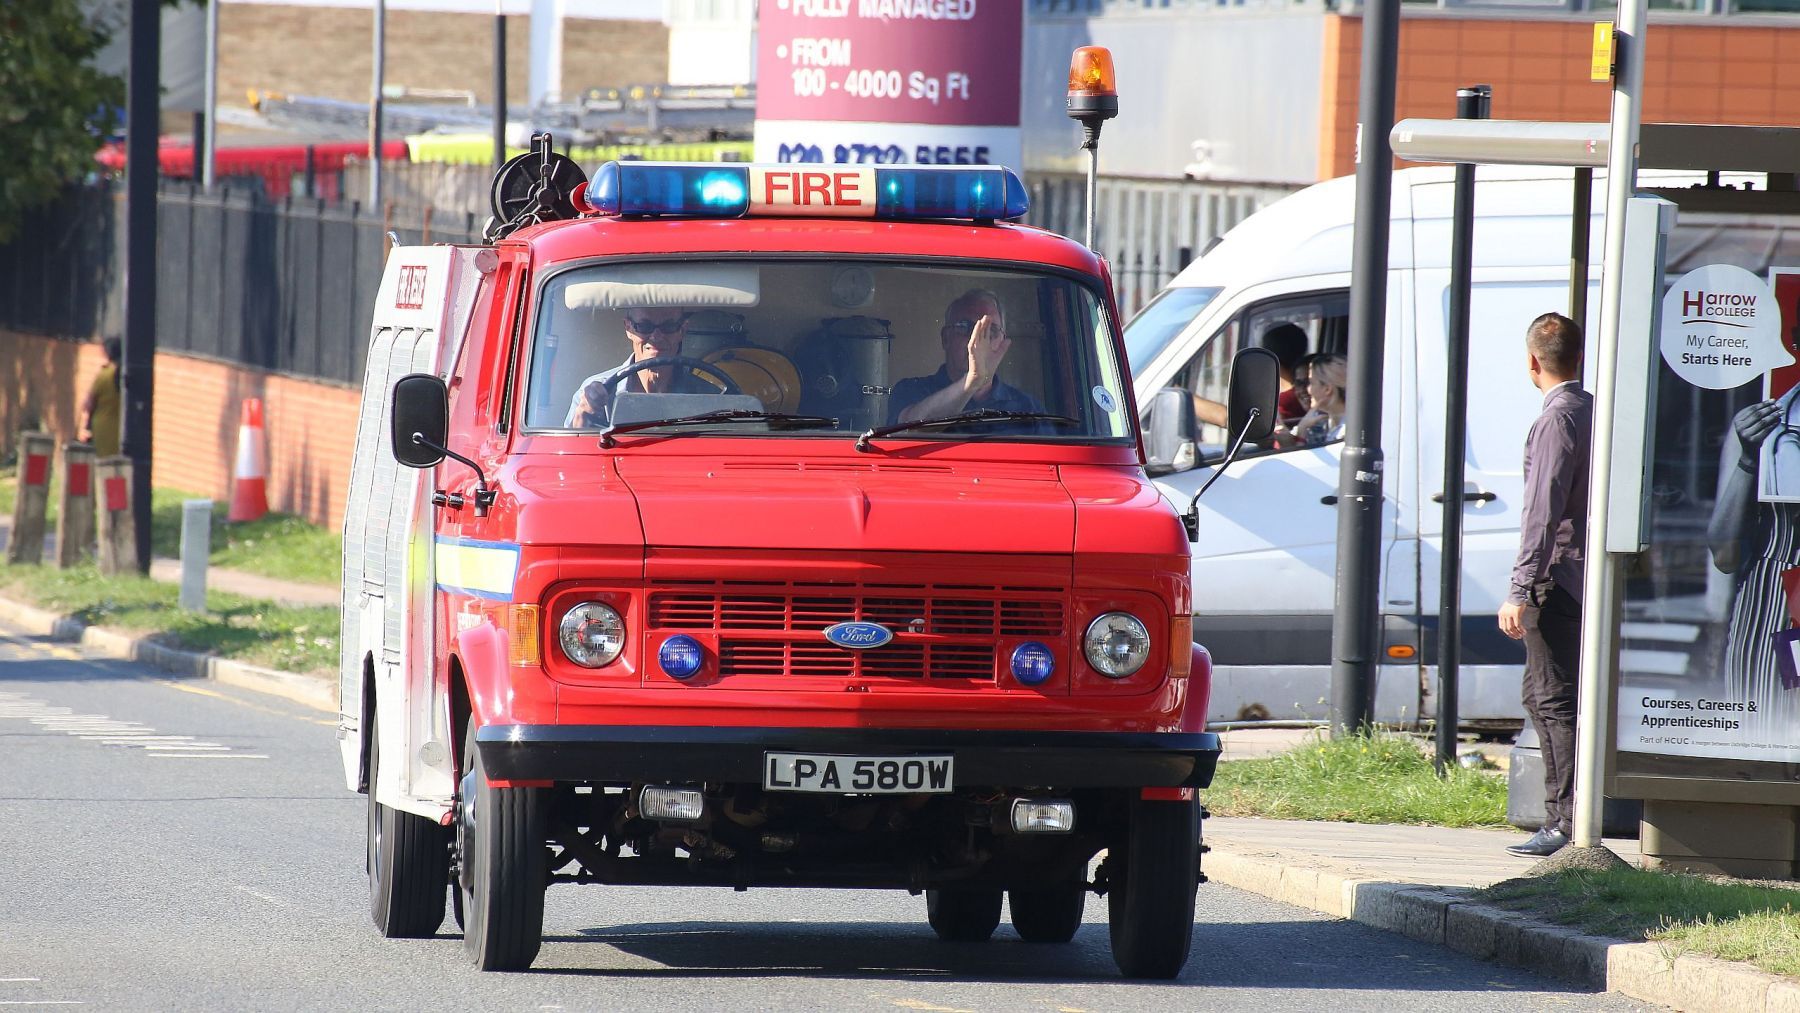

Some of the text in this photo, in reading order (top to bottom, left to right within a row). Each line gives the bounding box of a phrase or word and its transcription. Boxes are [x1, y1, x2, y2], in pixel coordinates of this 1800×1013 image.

[793, 0, 977, 20] FULLY MANAGED
[791, 38, 851, 66] FROM
[791, 69, 826, 97] 100
[844, 70, 902, 98] 4000
[908, 71, 940, 104] Sq
[946, 73, 970, 99] Ft
[765, 172, 862, 206] FIRE
[1682, 290, 1757, 317] Harrow
[1706, 306, 1756, 317] COLLEGE
[1686, 334, 1749, 349] My Career,
[1682, 352, 1752, 366] Starts Here
[840, 626, 876, 642] Ford
[1641, 696, 1757, 712] Courses, Careers &
[1641, 715, 1739, 731] Apprenticeships
[1640, 736, 1654, 744] Part
[1664, 737, 1689, 745] HCUC
[769, 758, 949, 789] LPA 580W
